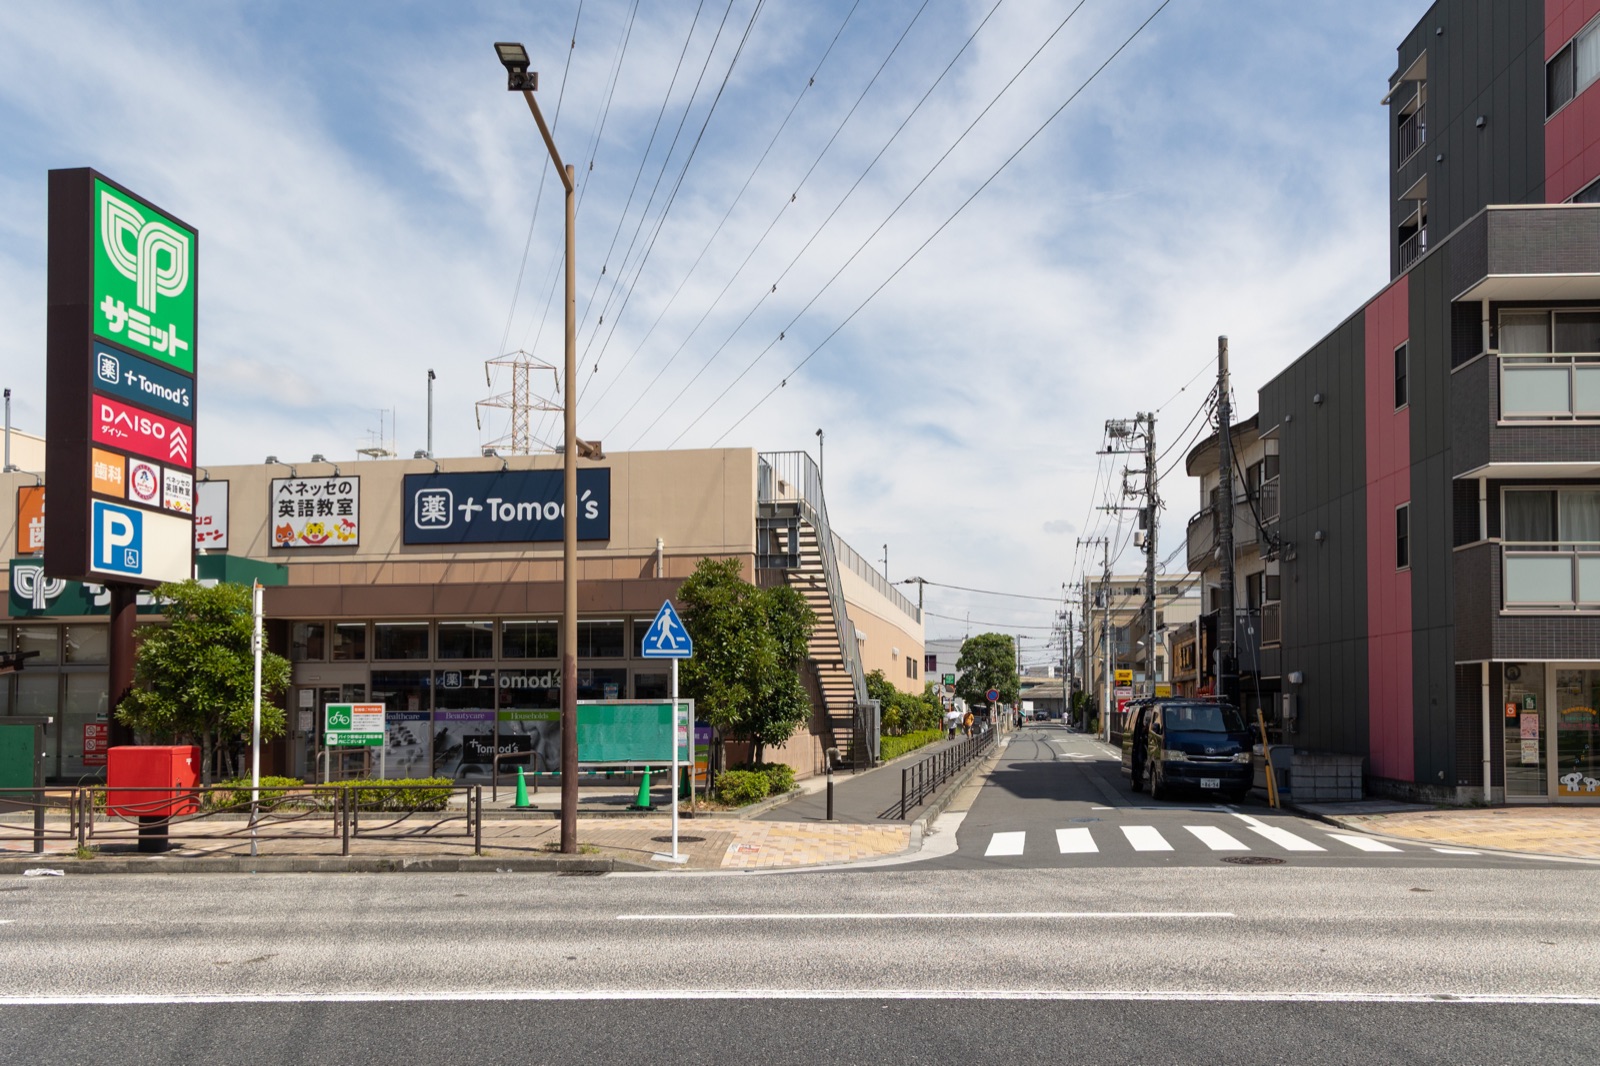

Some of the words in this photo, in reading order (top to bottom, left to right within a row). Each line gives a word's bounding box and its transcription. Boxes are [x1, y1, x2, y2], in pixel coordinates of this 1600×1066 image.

[100, 295, 188, 357] サミット
[101, 358, 116, 380] 薬
[101, 404, 165, 439] DAISO
[101, 425, 128, 438] ダイソー
[94, 462, 122, 485] 歯科
[166, 476, 191, 488] ベネッセの
[166, 483, 191, 497] 英語教室
[279, 481, 352, 496] ベネッセの
[278, 498, 353, 518] 英語教室
[421, 495, 447, 523] 薬
[487, 489, 599, 522] Tomo's
[103, 509, 134, 564] P
[446, 672, 459, 686] 薬
[445, 712, 485, 720] Beautycare
[511, 712, 549, 720] Households
